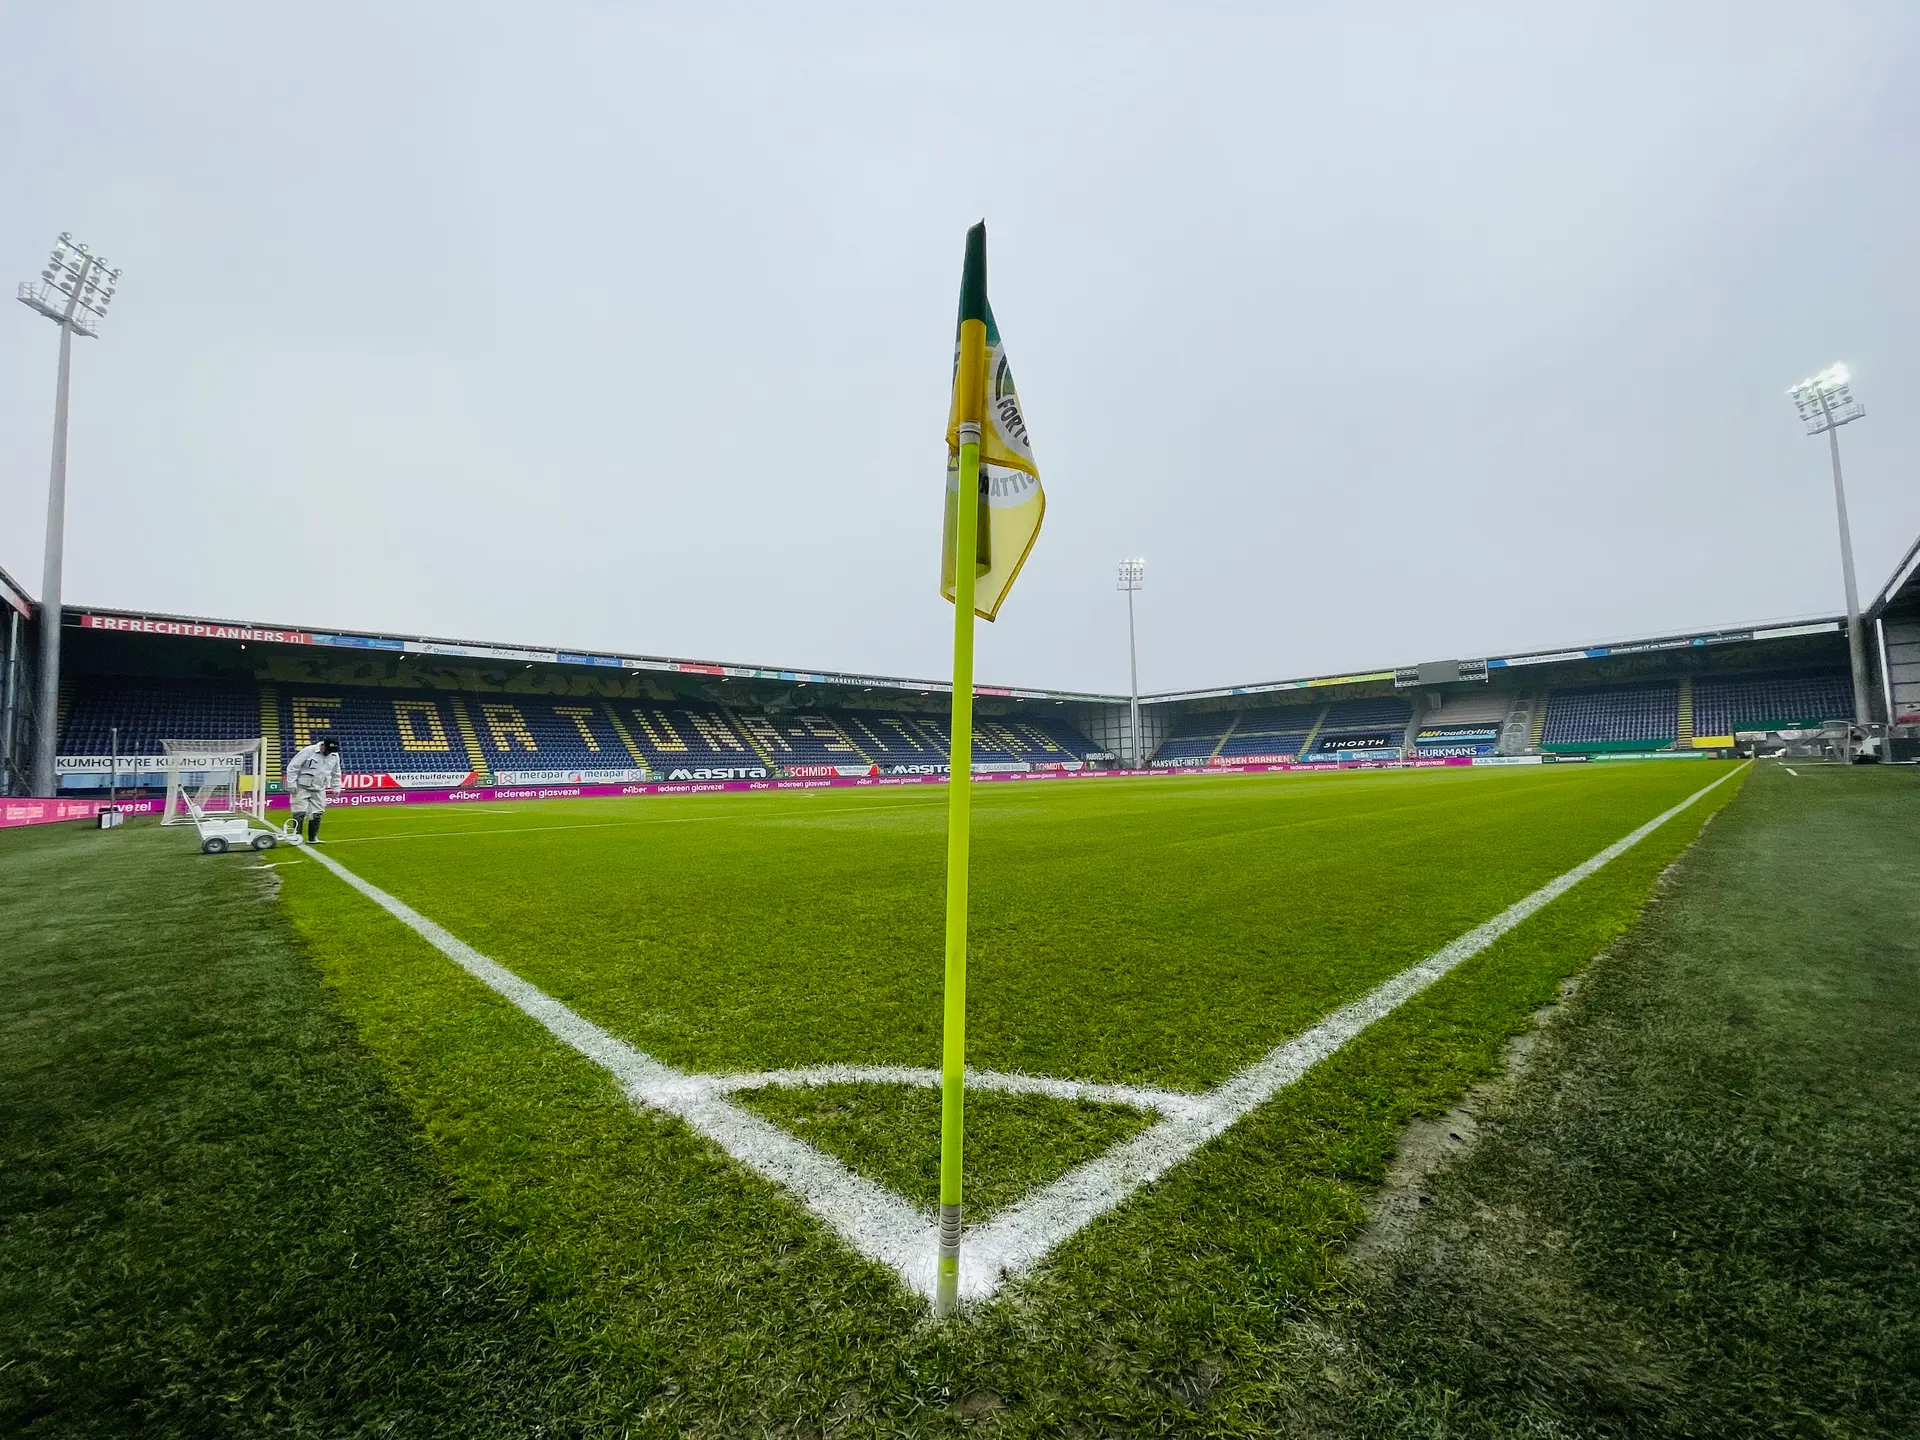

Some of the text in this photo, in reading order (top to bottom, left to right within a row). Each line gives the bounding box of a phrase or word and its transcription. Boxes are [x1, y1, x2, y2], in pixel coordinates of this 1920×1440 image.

[91, 617, 304, 644] ERFRECHTPLANNERS.nl
[560, 654, 587, 663] Dahmen
[593, 657, 619, 665] Dahmen
[1418, 747, 1477, 757] HURKMANS
[57, 758, 113, 768] KUMHO
[116, 758, 151, 768] TYRE
[210, 757, 241, 766] TYRE
[1214, 755, 1291, 766] HANSEN DRANKEN
[520, 770, 564, 780] merapar
[584, 769, 625, 779] merapar
[790, 766, 833, 777] SCHMIDT
[340, 774, 386, 788] MIDT
[395, 773, 465, 781] Hefschuifdeuren
[494, 786, 647, 799] Iedereen glasvezel efiber
[658, 784, 690, 793] Iedereen
[691, 783, 724, 793] glasvezel
[351, 793, 406, 806] glasvezel
[449, 790, 481, 800] efiber
